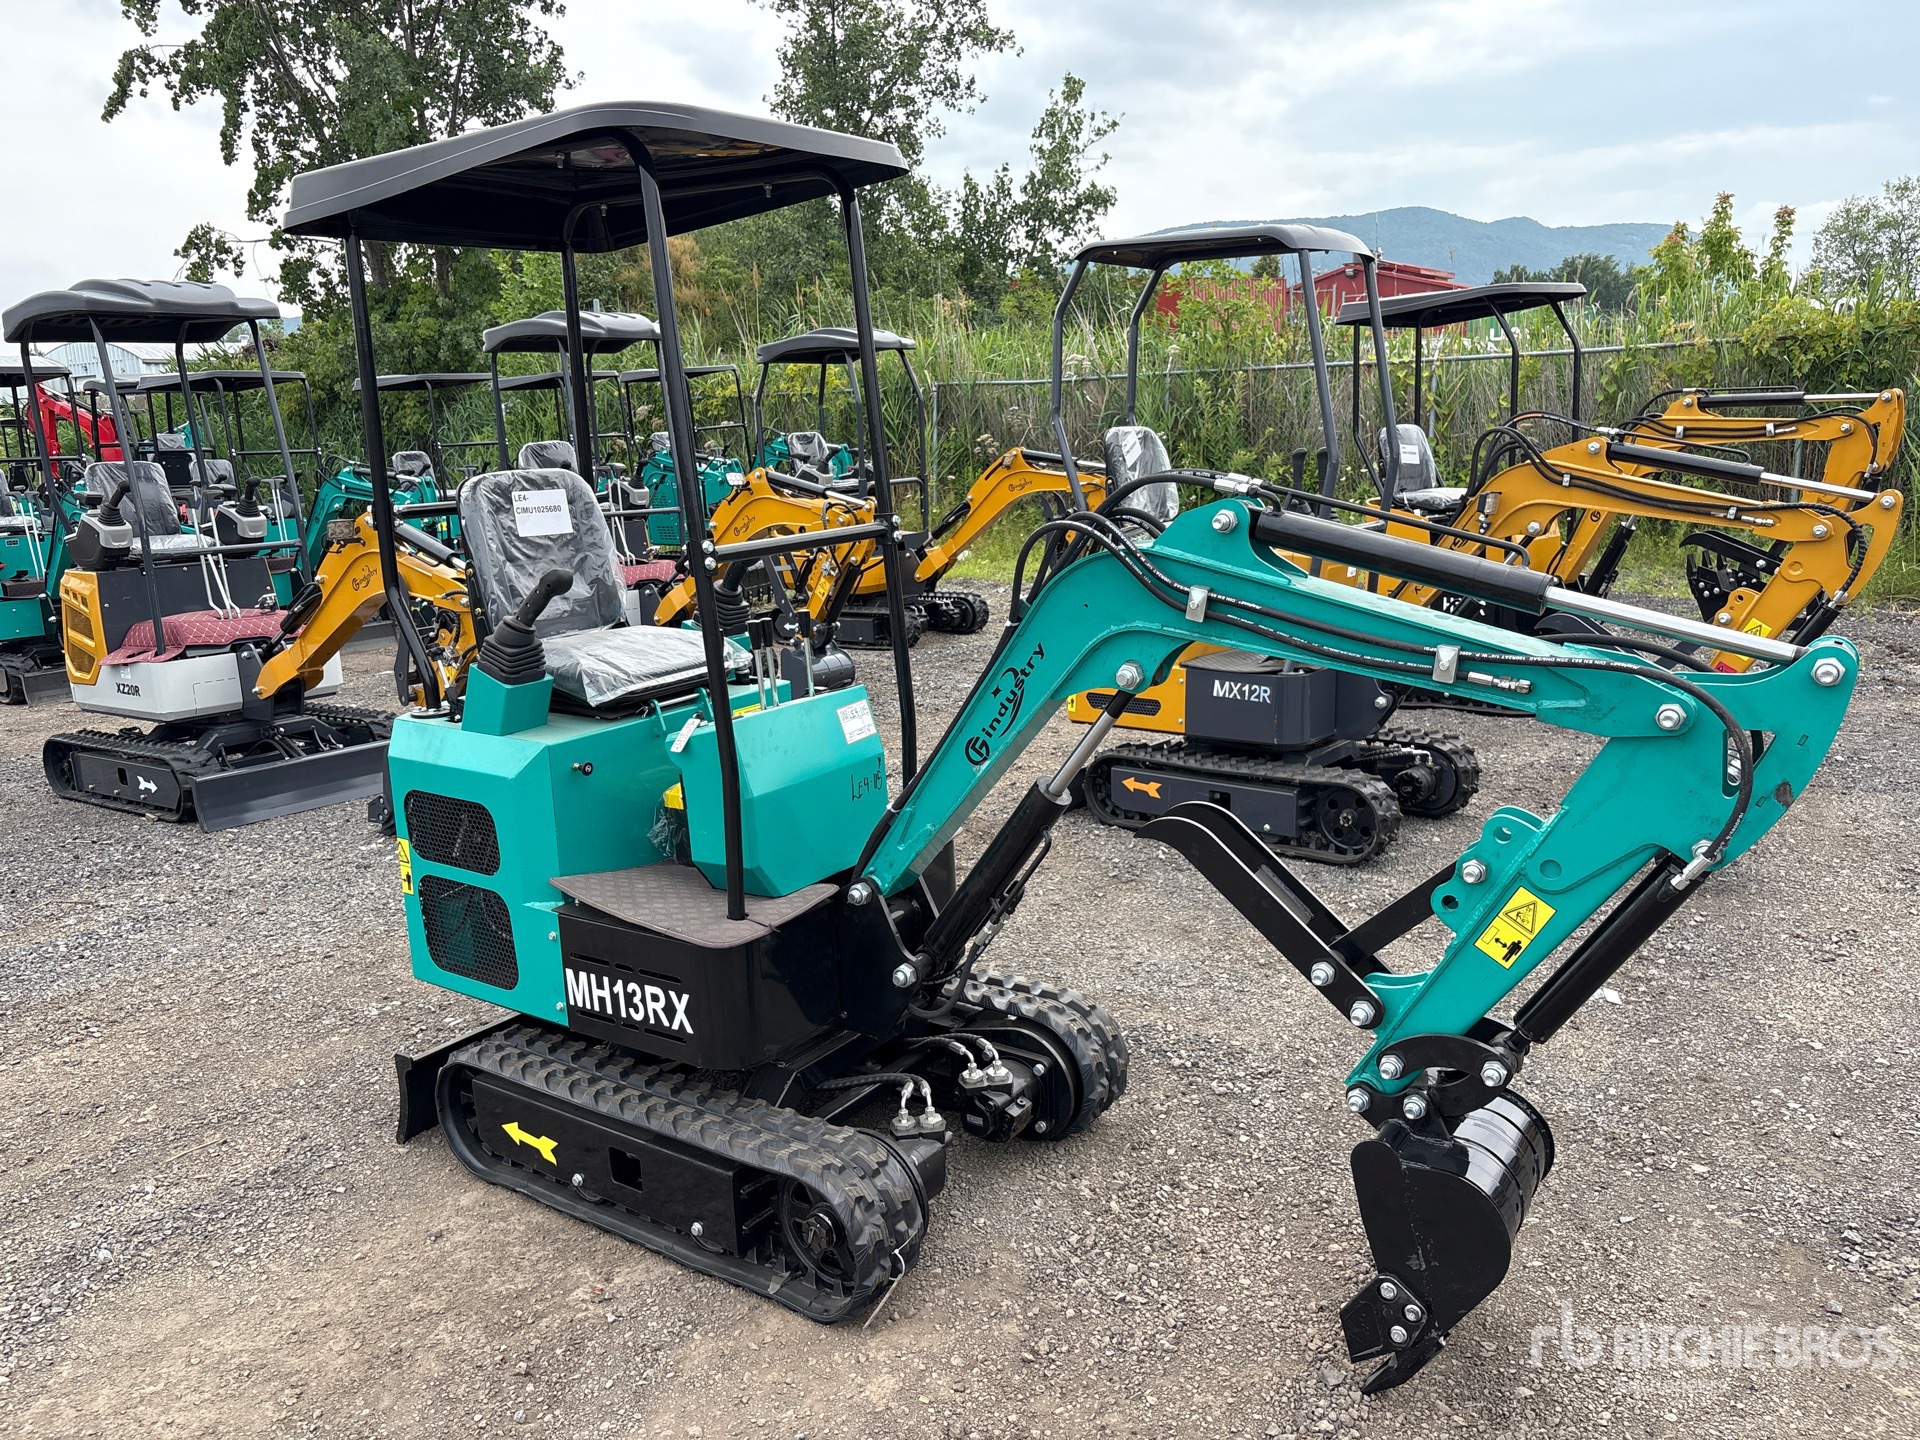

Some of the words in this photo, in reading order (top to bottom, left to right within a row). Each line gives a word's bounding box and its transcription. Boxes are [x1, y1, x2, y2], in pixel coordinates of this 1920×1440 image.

[513, 494, 530, 502] LE4-
[115, 682, 141, 697] XZ20R
[1213, 680, 1271, 704] MX12R
[565, 968, 694, 1034] MH13RX
